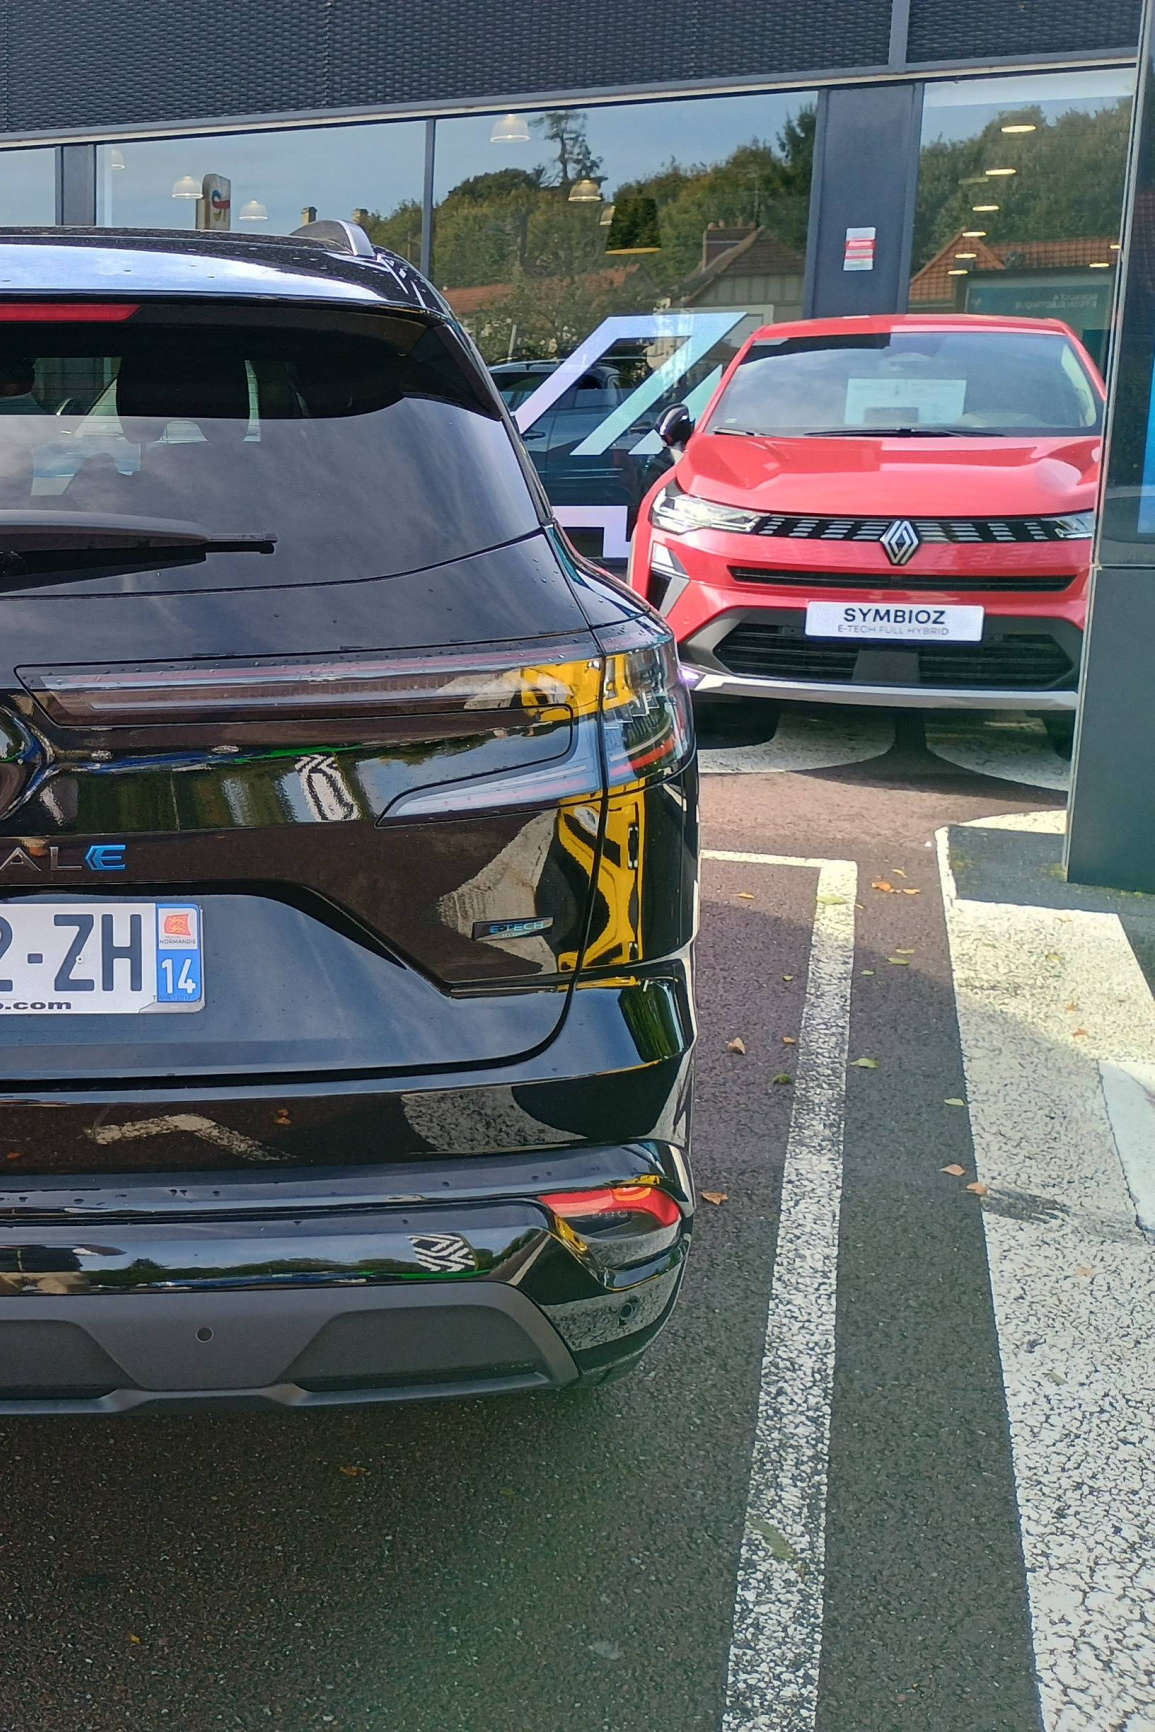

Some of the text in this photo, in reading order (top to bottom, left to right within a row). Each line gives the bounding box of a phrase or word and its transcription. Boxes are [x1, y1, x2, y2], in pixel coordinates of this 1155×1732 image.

[843, 607, 946, 625] SYMBIOZ
[837, 624, 949, 636] E-TECH FULL HYBRID
[489, 920, 545, 935] E-TECH
[161, 958, 197, 995] 14
